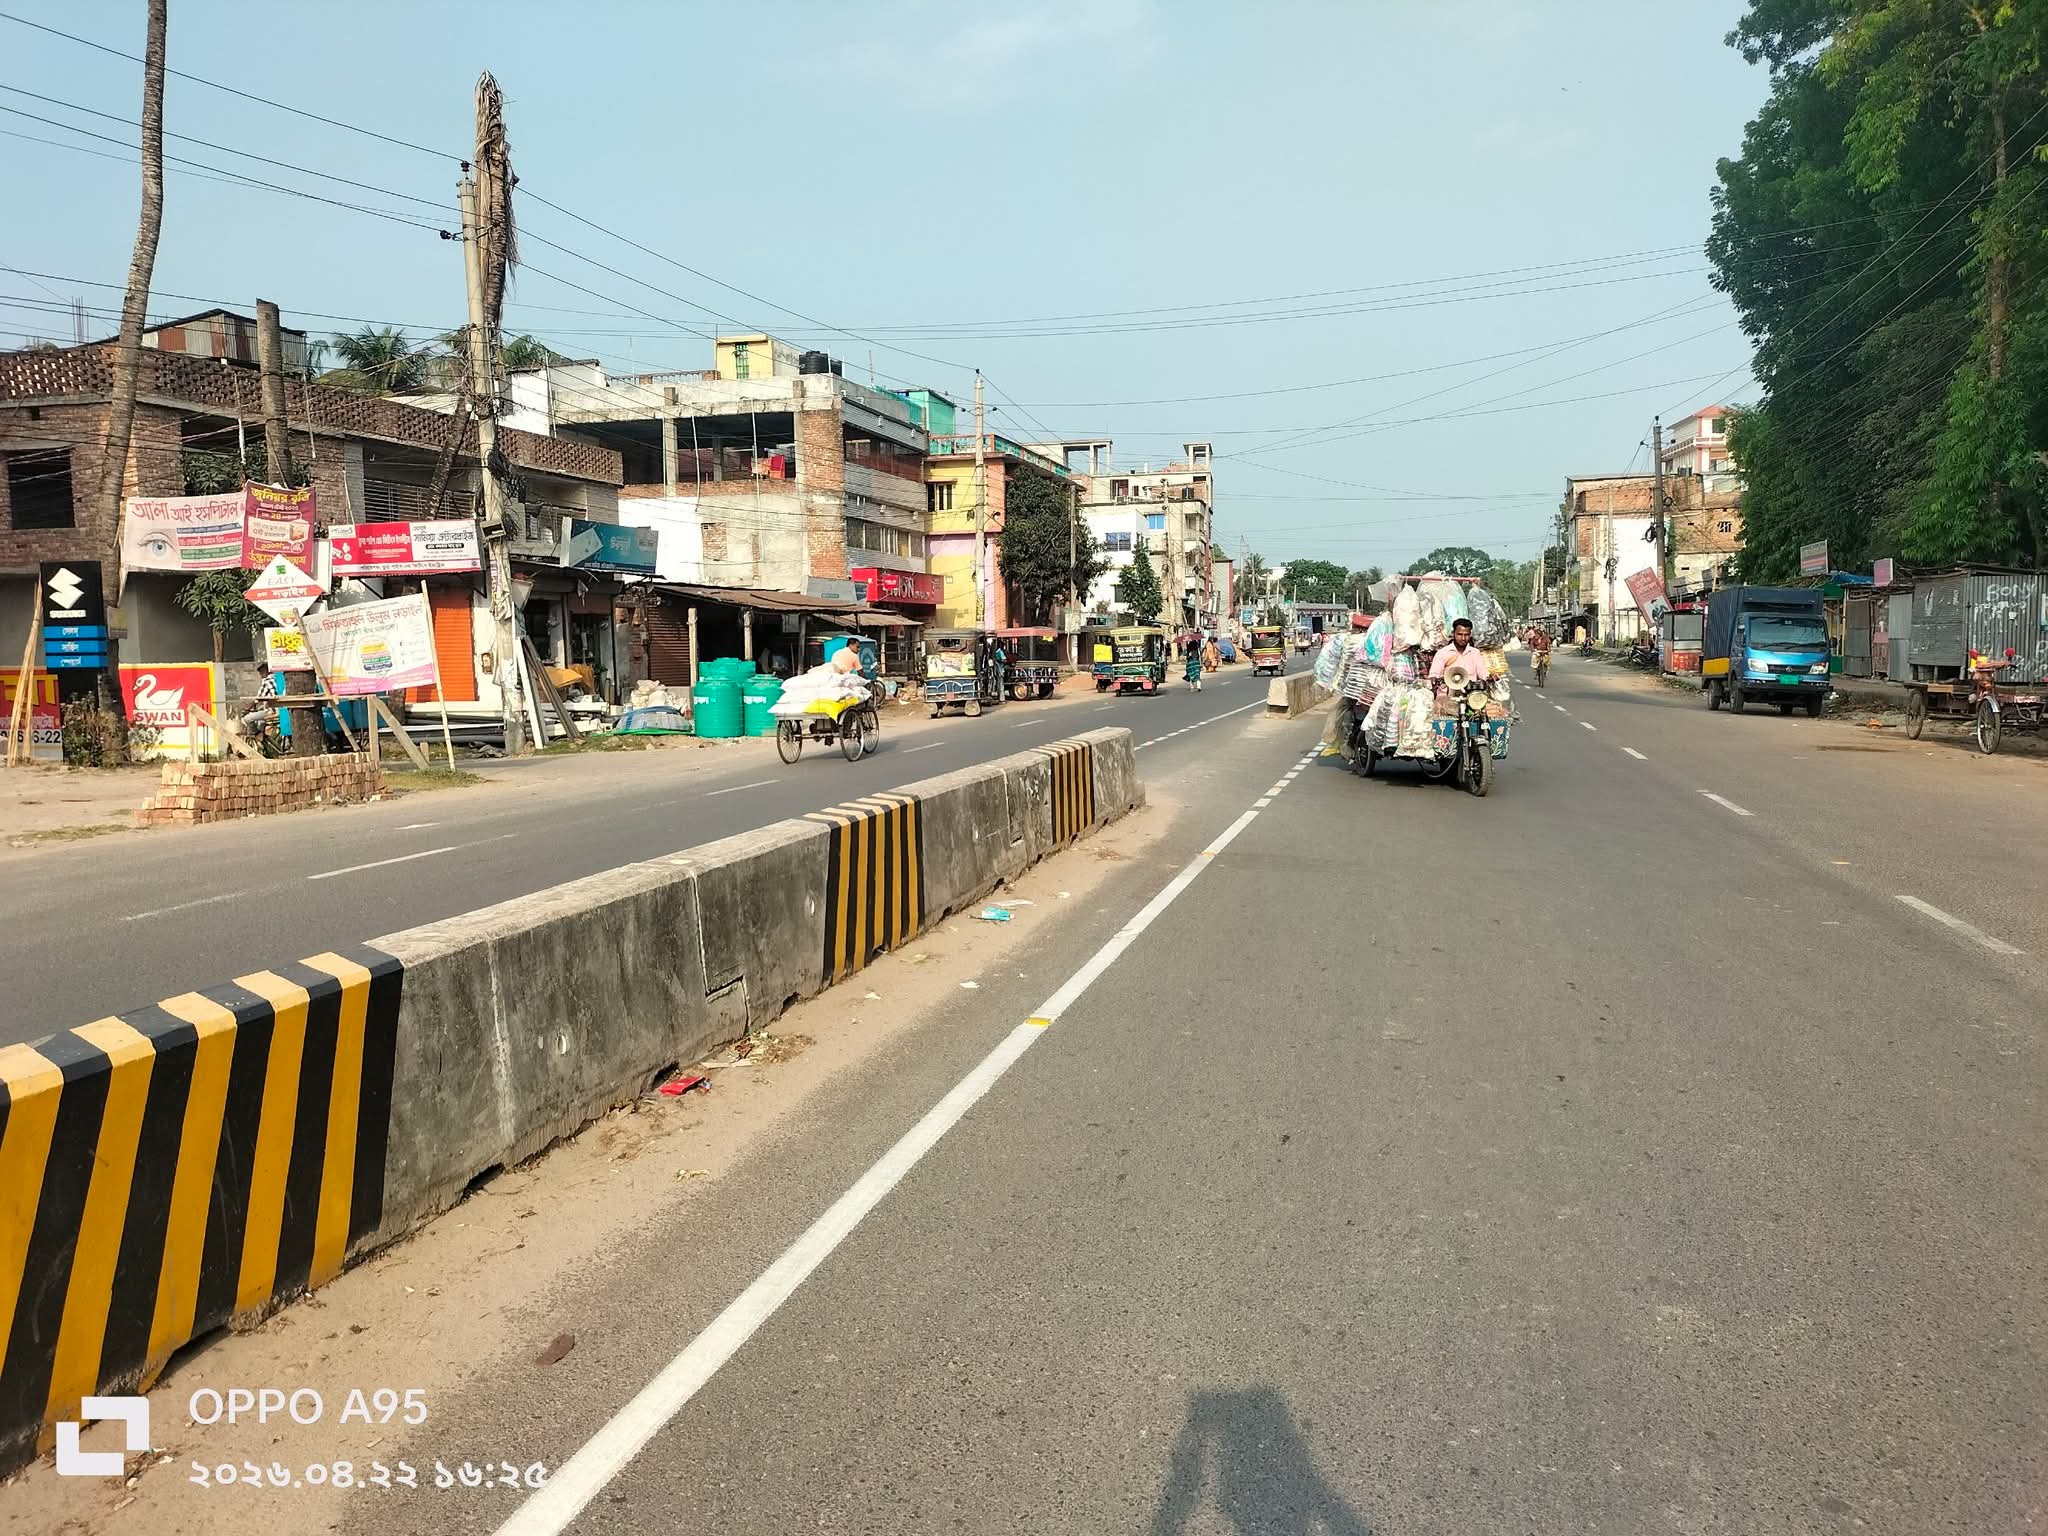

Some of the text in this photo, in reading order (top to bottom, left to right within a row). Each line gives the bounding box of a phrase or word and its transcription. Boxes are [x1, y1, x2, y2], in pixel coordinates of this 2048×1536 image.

[171, 504, 193, 522] আই
[194, 501, 239, 521] হসপিটাল
[267, 577, 296, 586] EASY
[135, 712, 182, 722] SWAN
